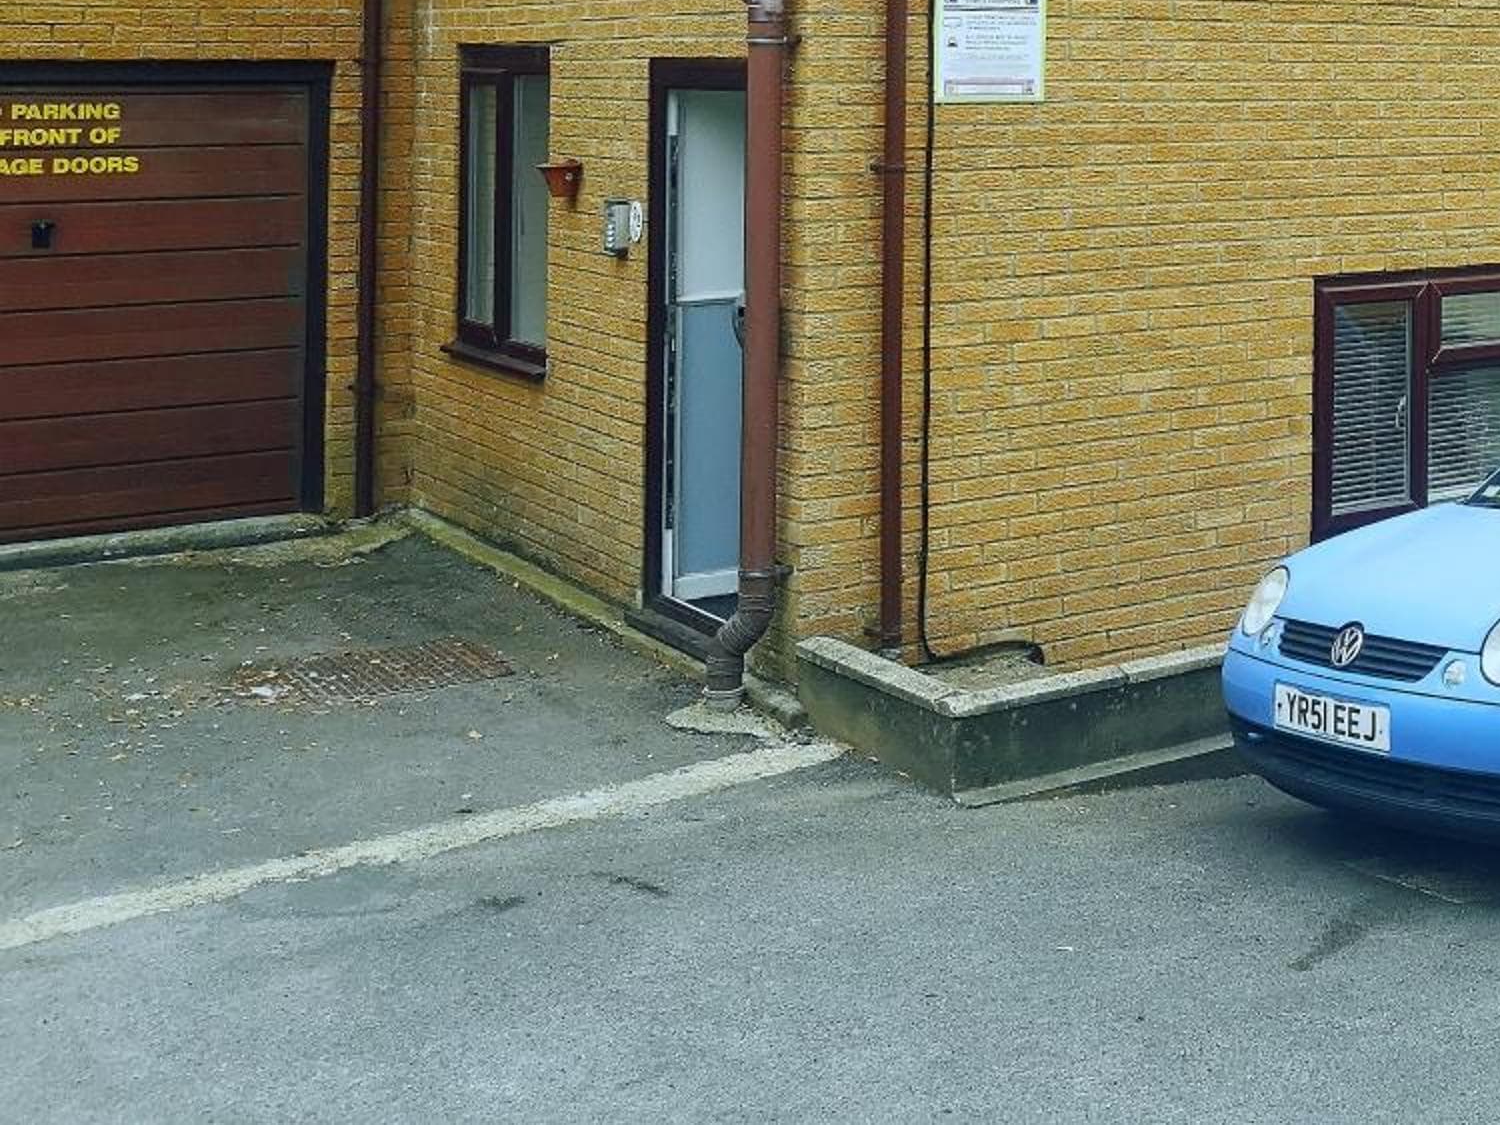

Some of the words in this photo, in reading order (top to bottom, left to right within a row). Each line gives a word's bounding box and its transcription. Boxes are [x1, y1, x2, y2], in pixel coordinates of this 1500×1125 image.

[11, 102, 121, 120] PARKING
[0, 128, 82, 146] FRONT
[89, 127, 121, 144] OF
[53, 156, 139, 174] DOORS
[1333, 704, 1376, 742] EEJ
